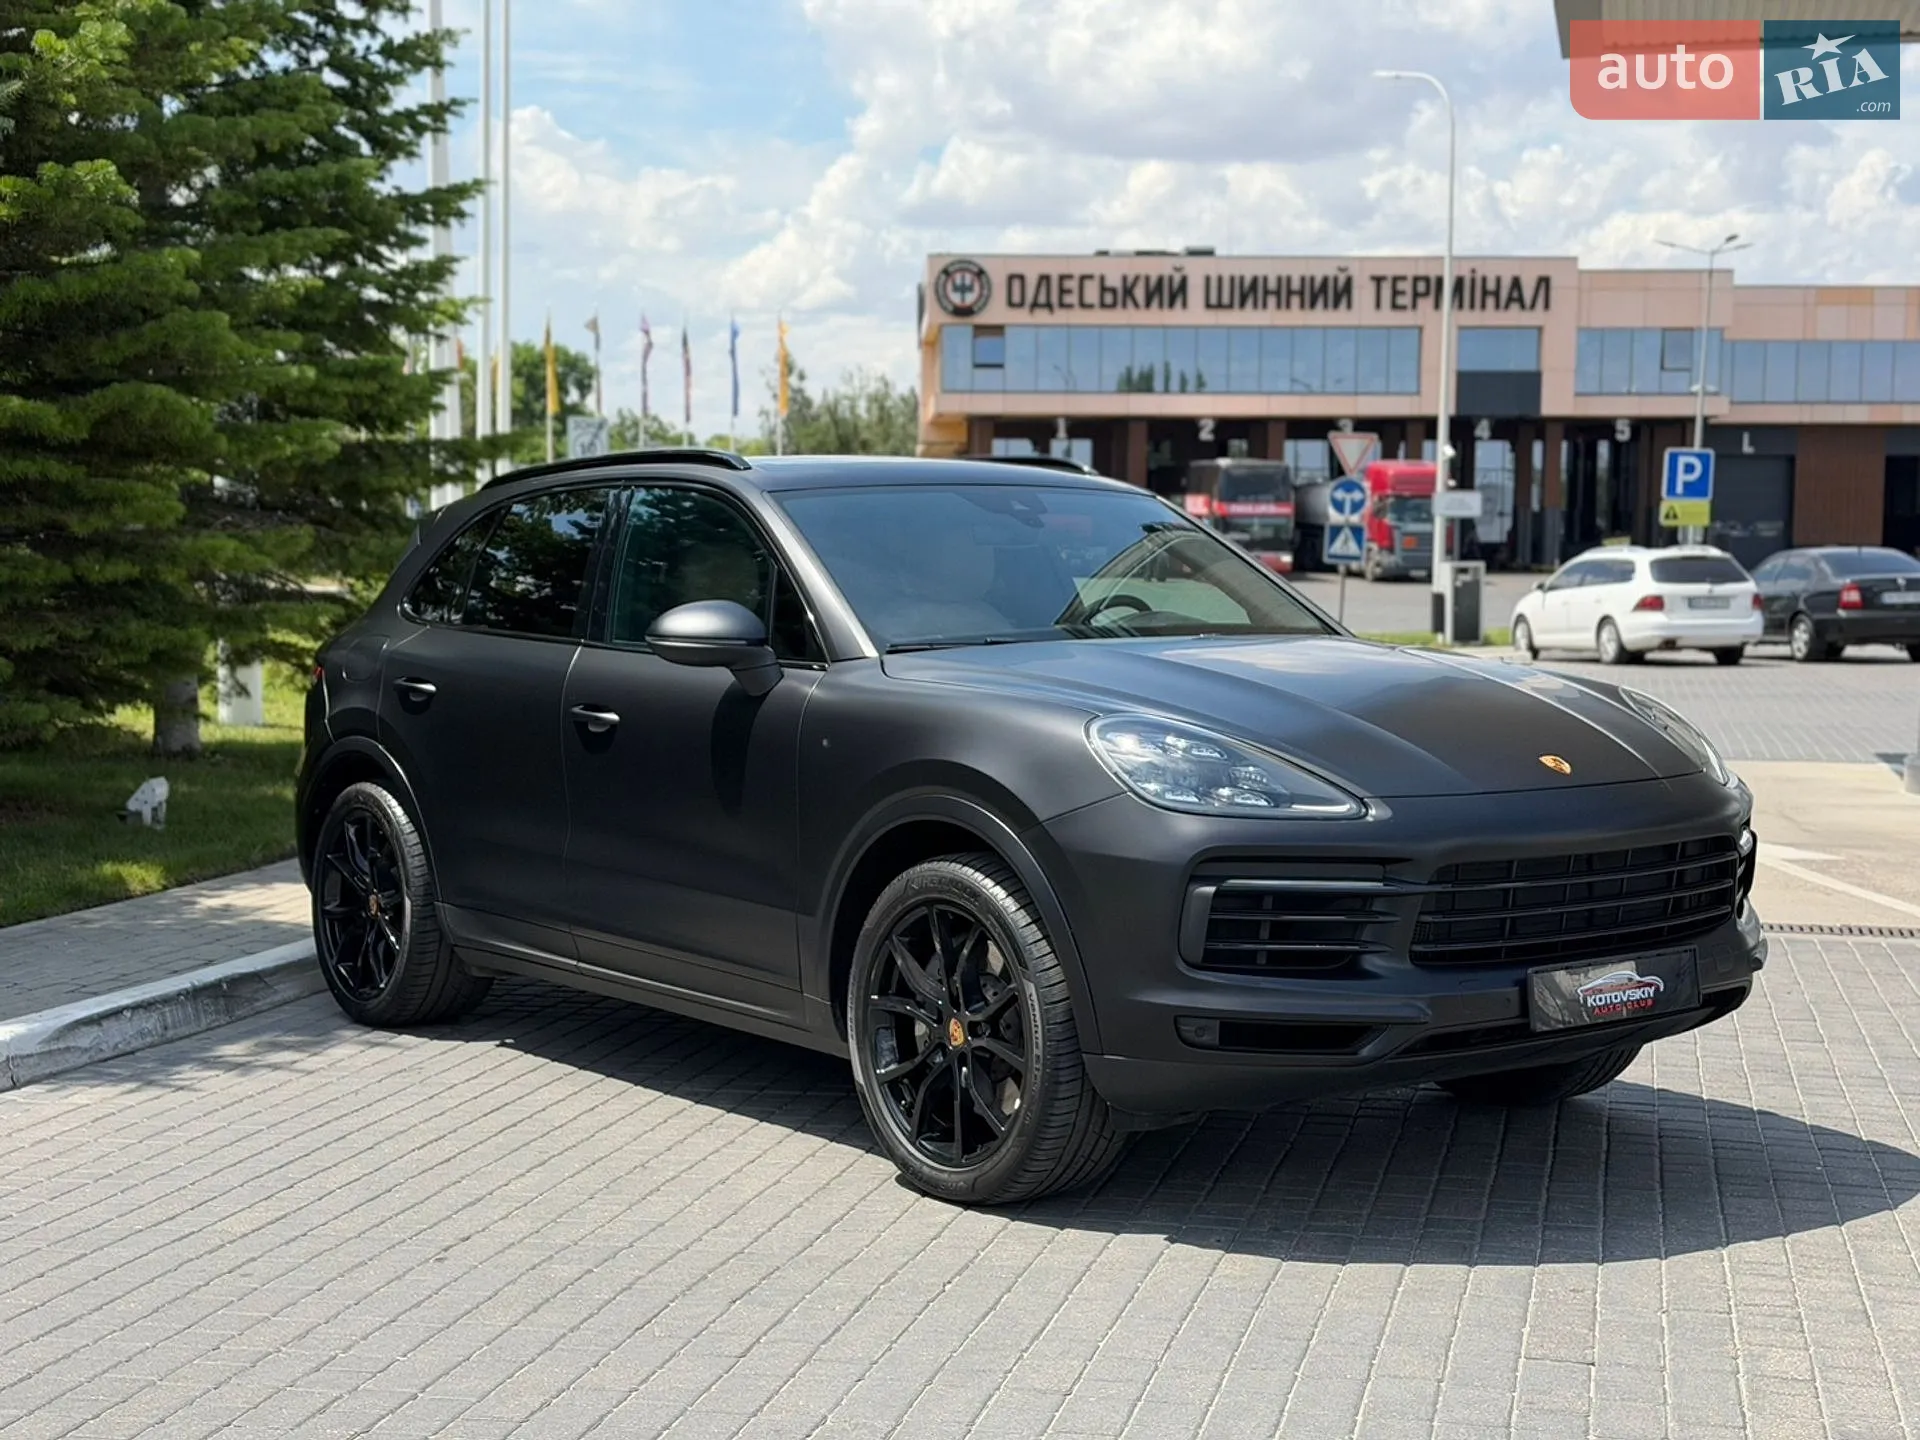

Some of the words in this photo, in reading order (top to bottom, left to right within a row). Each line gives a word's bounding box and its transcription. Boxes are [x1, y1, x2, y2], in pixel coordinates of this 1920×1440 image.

[1006, 265, 1188, 314] ОДЕСЬКИЙ
[1204, 265, 1353, 311] ШИННИЙ
[1370, 268, 1552, 312] ТЕРМІНАЛ
[1198, 418, 1215, 441] 2
[1474, 418, 1491, 440] 4
[1614, 418, 1632, 442] 5
[1675, 455, 1703, 495] P
[1587, 986, 1656, 1007] KOTOVSKIY
[1594, 1004, 1621, 1015] AUTO
[1626, 999, 1653, 1009] CLUB
